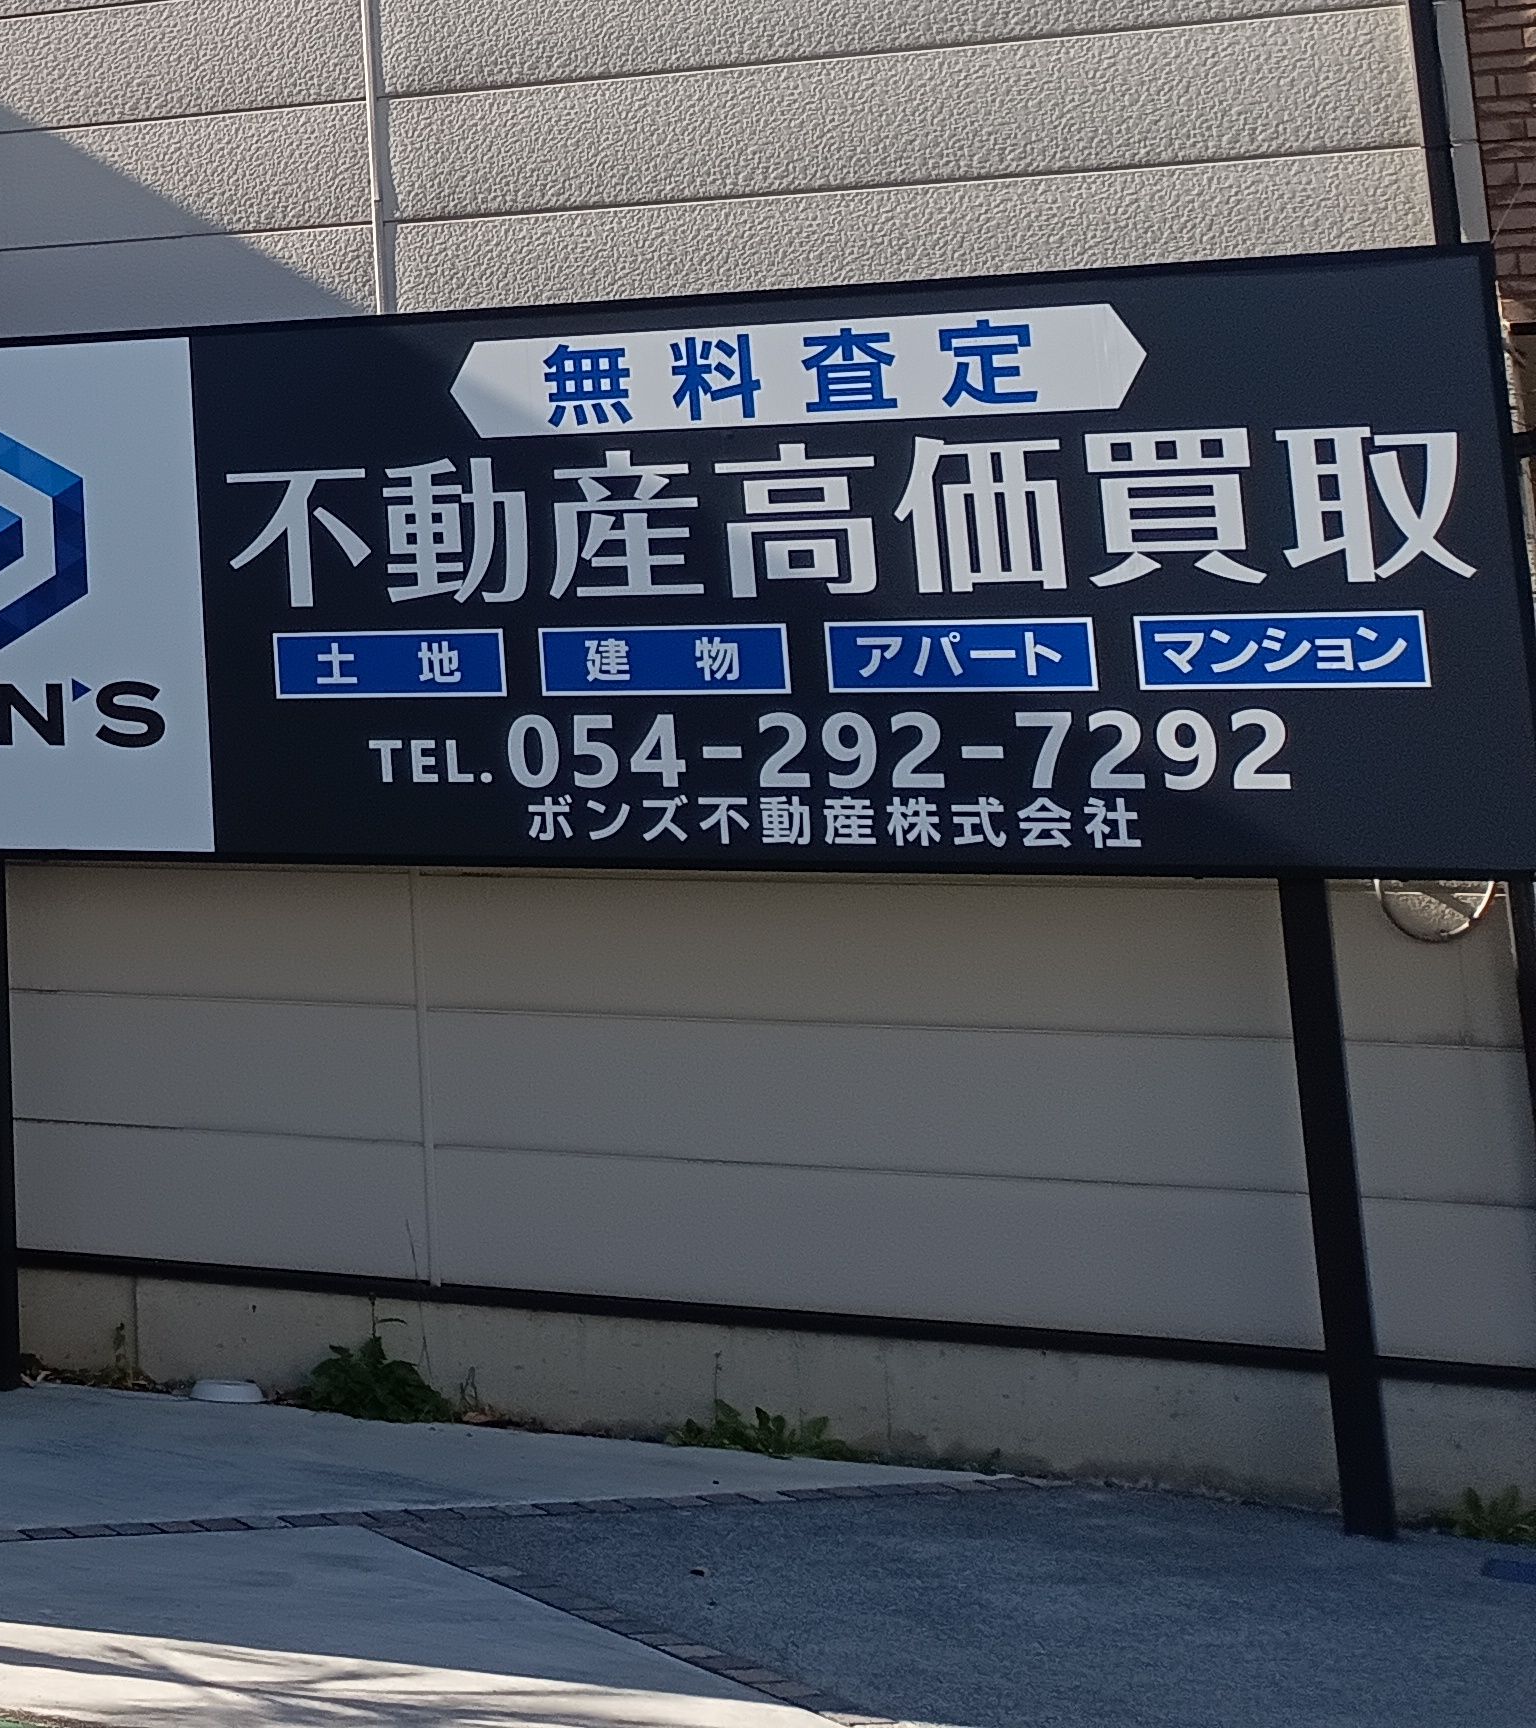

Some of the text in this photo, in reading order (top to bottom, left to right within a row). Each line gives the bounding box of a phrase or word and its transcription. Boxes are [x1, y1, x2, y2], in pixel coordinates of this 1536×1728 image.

[545, 319, 1038, 426] 無料査定
[226, 424, 1477, 608] 不動産高価買取
[317, 642, 462, 684] 土地
[584, 636, 740, 683] 建物
[855, 630, 1063, 677] アパート
[1154, 626, 1408, 674] マンション
[368, 708, 1292, 790] TEL. 054-292-7292
[527, 794, 1144, 848] ボンズ不動産株式会社
